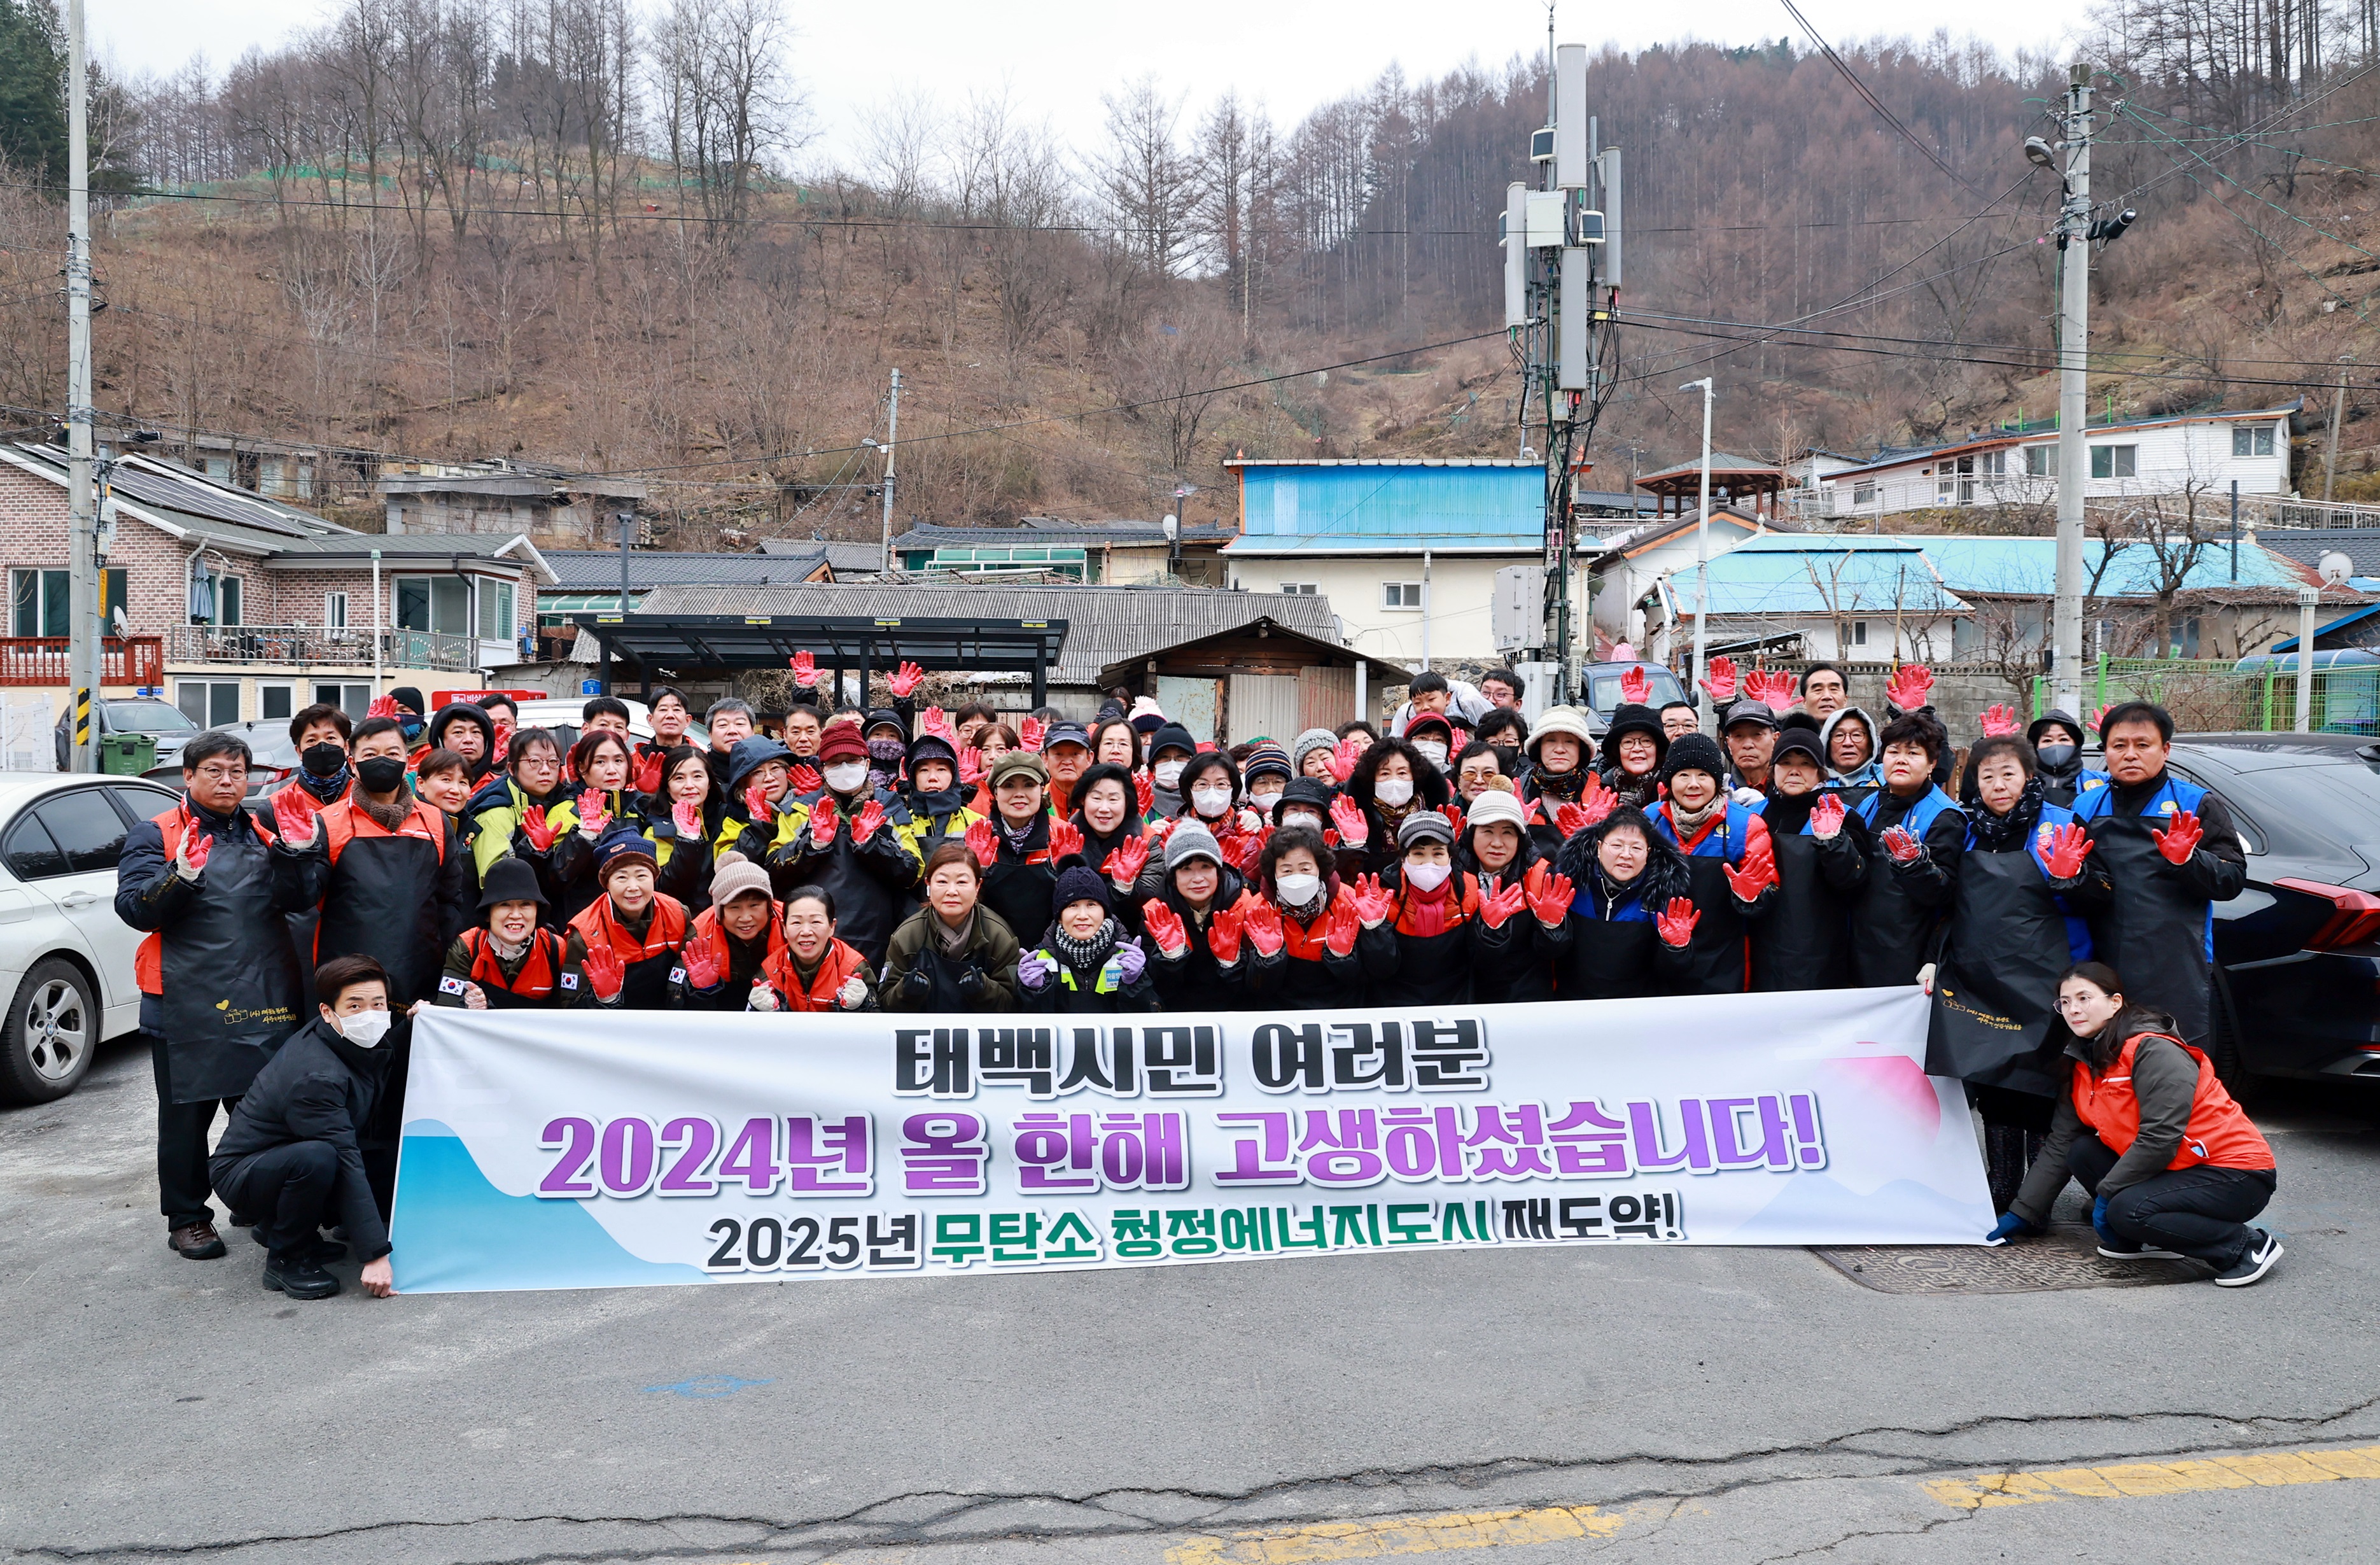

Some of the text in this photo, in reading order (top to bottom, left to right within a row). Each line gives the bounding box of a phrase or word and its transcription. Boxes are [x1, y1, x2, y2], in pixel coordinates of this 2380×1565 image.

[895, 1019, 1487, 1095] 태백시민 여러분
[539, 1094, 1821, 1195] 2024년 올 한해 고생하셨습니다!
[707, 1193, 1679, 1268] 2025년 무탄소 청정에너지도시 재도약!
